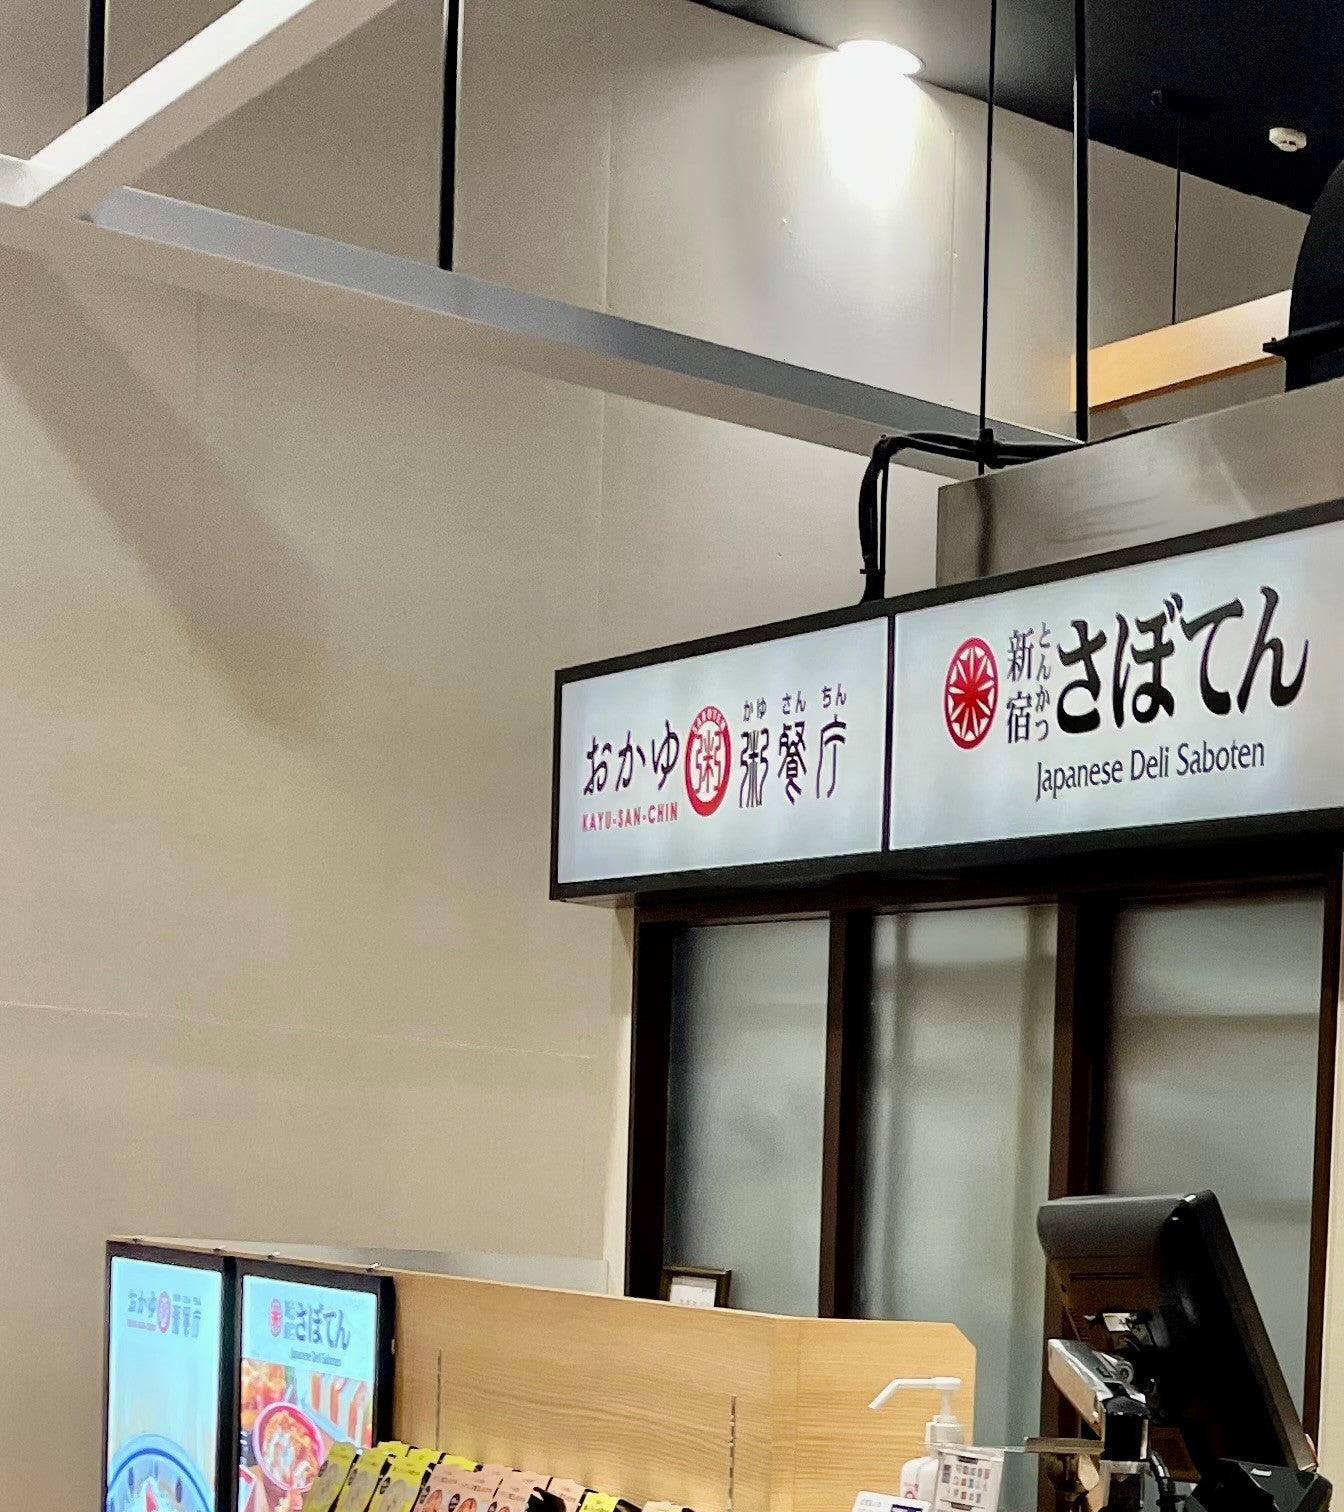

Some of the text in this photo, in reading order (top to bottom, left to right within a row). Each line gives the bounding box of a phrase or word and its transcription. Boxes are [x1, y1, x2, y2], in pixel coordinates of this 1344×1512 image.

[1006, 629, 1035, 746] 新宿
[1035, 622, 1053, 743] とんかつ
[1056, 586, 1309, 736] さぼてん
[584, 719, 680, 797] おかゆ
[1035, 738, 1266, 802] Japanese Deli Saboten
[582, 803, 678, 832] KAYU-SAN-CHIN
[296, 1303, 351, 1350] さぼてん
